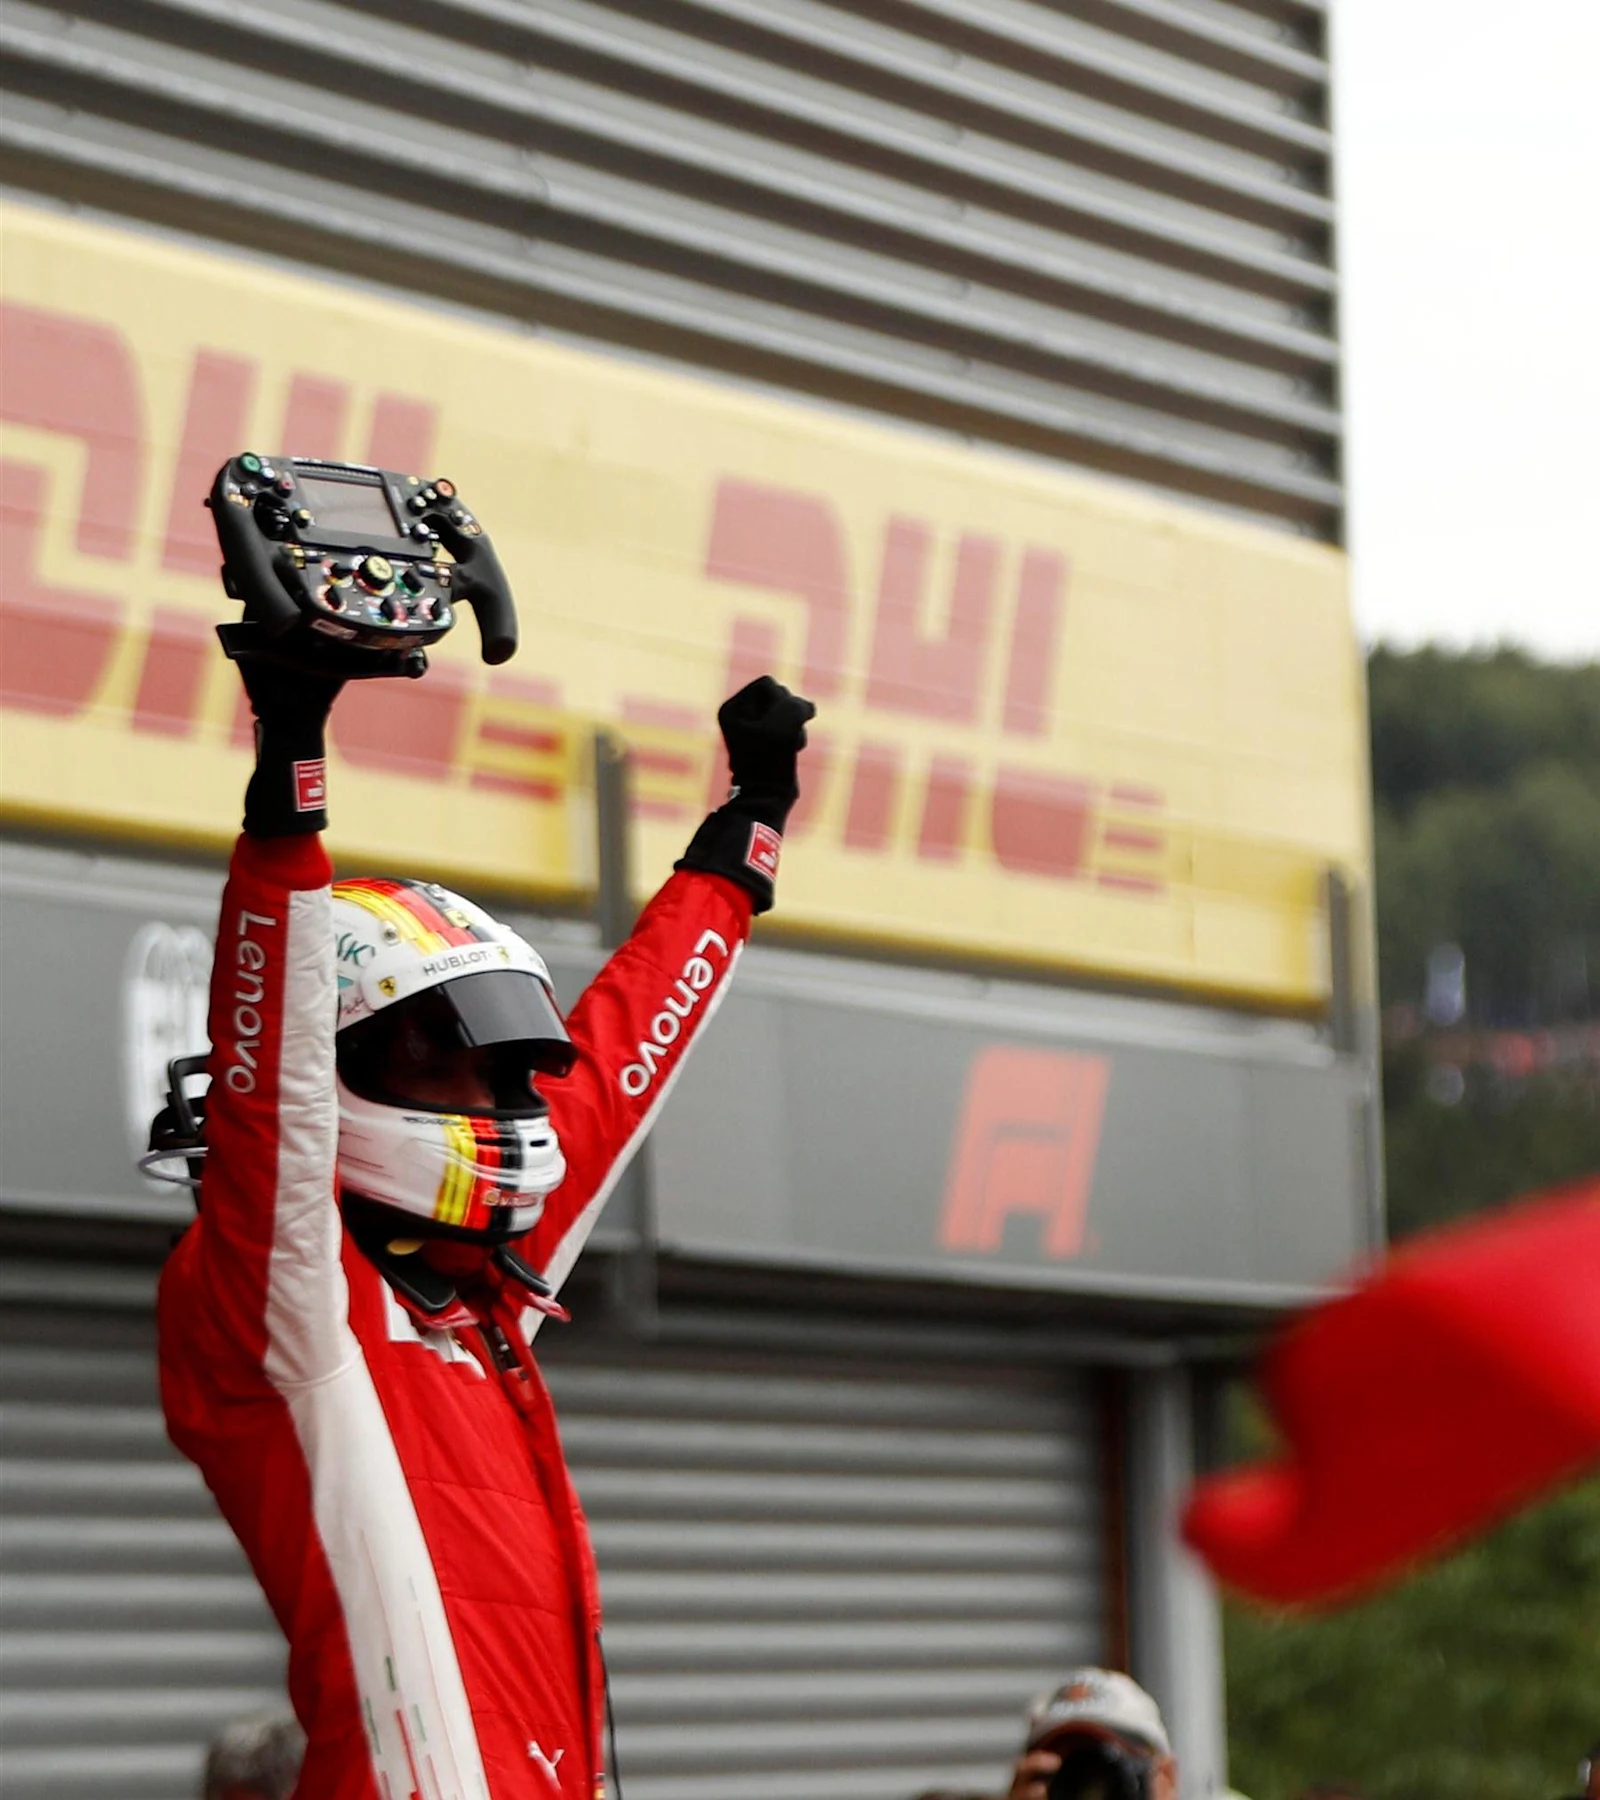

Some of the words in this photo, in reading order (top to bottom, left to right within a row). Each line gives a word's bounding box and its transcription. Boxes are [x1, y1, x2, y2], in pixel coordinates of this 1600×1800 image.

[704, 479, 1093, 882] DHL
[226, 911, 277, 1093] Lenovo
[423, 950, 490, 977] HUBLOT
[619, 928, 729, 1096] Lenovo
